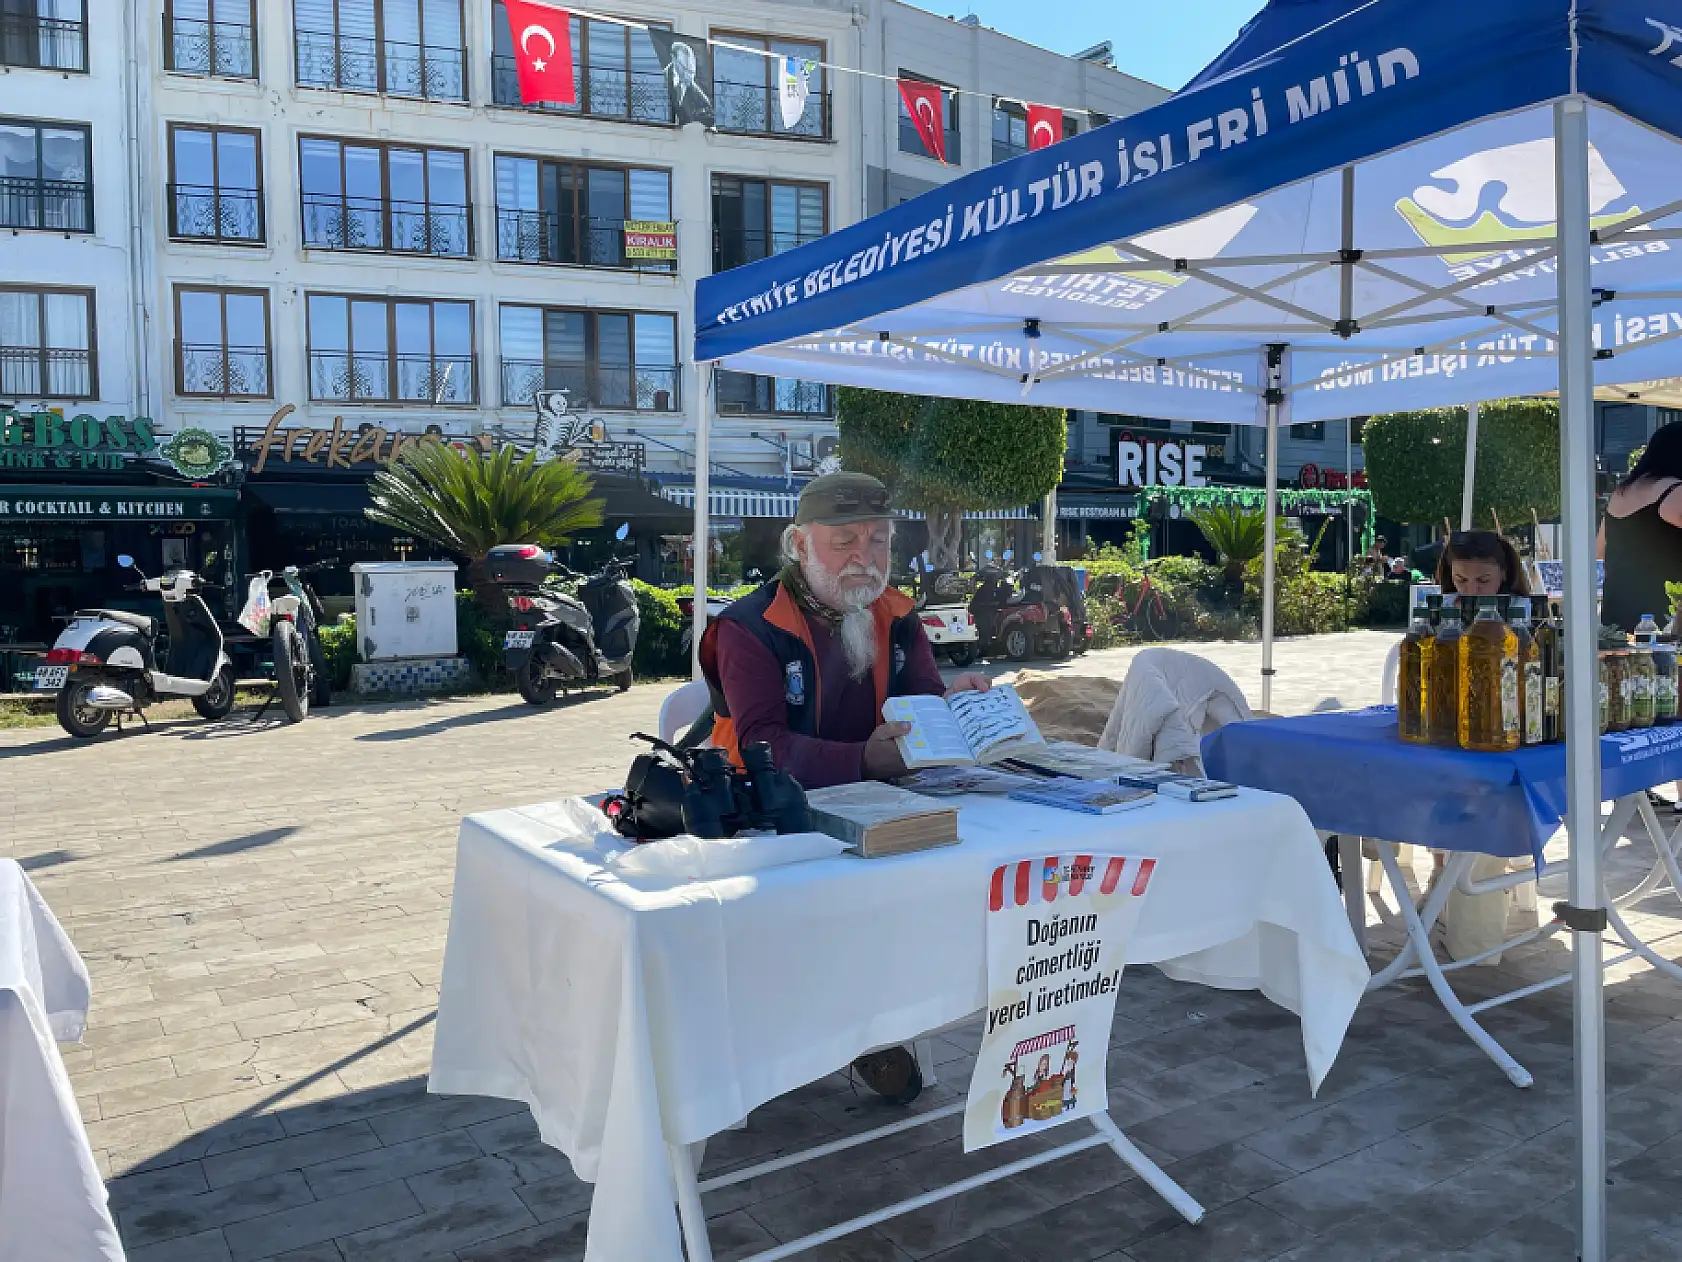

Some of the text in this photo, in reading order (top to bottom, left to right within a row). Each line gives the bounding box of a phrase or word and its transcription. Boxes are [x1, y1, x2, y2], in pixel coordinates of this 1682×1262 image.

[627, 235, 675, 247] KIRALIK
[803, 203, 954, 300] BELEDİYESİ
[959, 160, 1104, 242] KÜLTÜR
[32, 412, 155, 451] BOSS
[0, 450, 47, 468] INK
[80, 453, 126, 470] PUB
[1118, 440, 1207, 487] RISE
[15, 500, 95, 514] COCKTAIL
[98, 501, 112, 514] &
[117, 501, 184, 516] KITCHEN
[1027, 913, 1098, 946] Doğanın
[1015, 940, 1101, 985] cömertliği
[988, 969, 1119, 1034] yerel üretimde!
